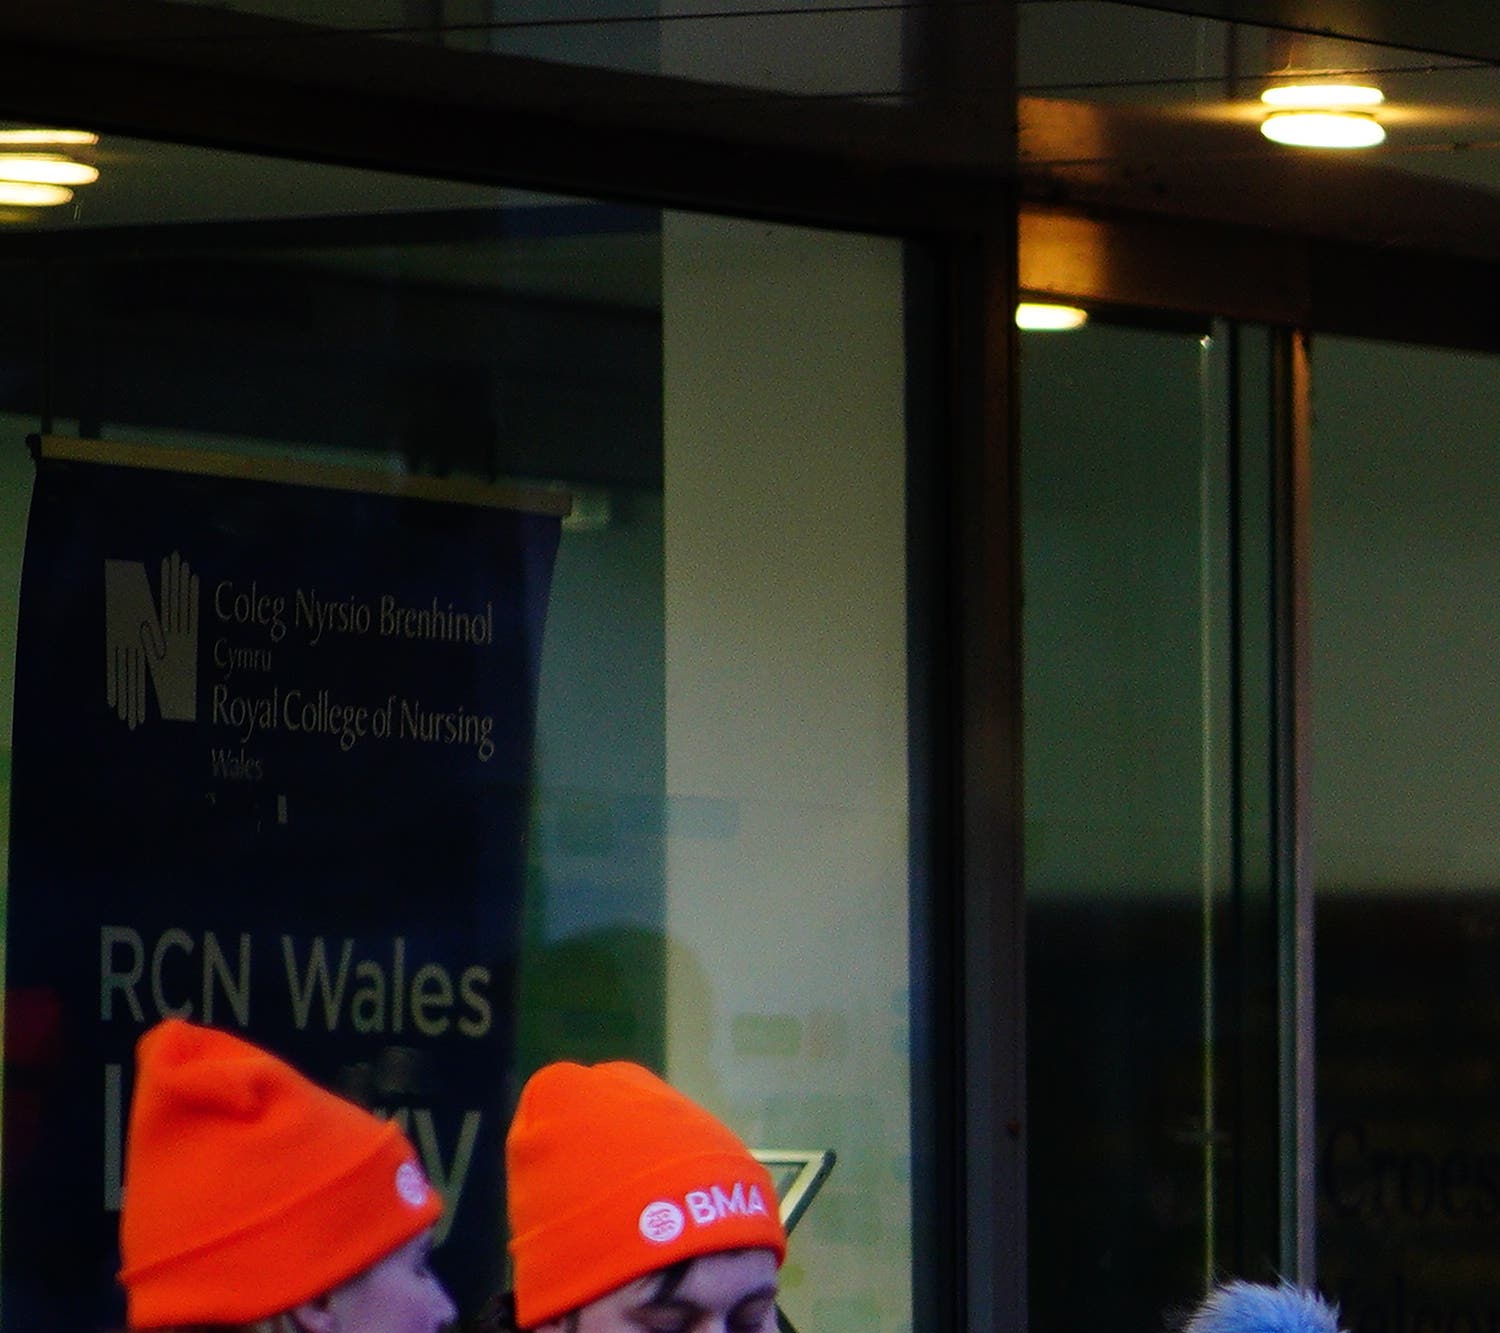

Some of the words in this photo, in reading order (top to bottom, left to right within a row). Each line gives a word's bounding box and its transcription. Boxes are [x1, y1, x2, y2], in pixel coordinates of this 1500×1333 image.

[214, 579, 288, 642] Coleg
[295, 587, 371, 647] Nyrsio
[379, 594, 494, 646] Brenhinol
[212, 638, 273, 680] Cymru
[212, 684, 279, 744] Royal
[283, 689, 369, 752] College
[372, 695, 398, 738] of
[399, 699, 496, 762] Nursing
[99, 925, 252, 1030] RCN
[281, 935, 493, 1038] Wales
[684, 1182, 768, 1224] BMA
